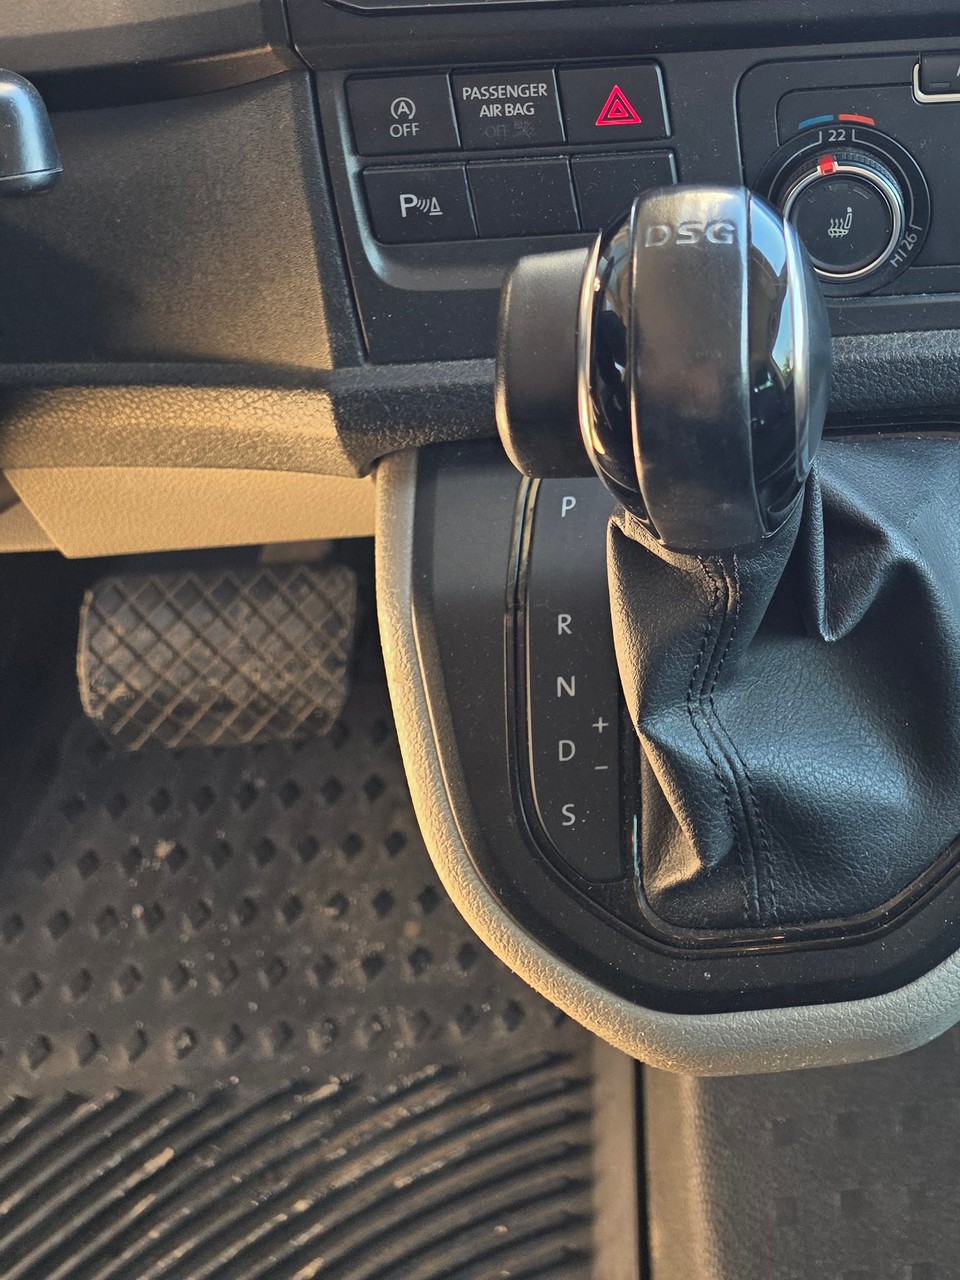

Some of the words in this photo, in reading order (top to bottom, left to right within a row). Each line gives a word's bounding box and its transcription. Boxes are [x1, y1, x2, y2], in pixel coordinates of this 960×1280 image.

[462, 83, 548, 101] PASSENGER
[479, 104, 502, 118] AIR
[504, 102, 535, 117] BAG
[389, 123, 420, 138] OFF
[828, 129, 846, 142] 22
[644, 222, 735, 248] DSG
[890, 248, 908, 268] HI
[902, 232, 918, 252] 26
[561, 496, 576, 518] P
[557, 613, 572, 635] R
[556, 676, 576, 698] N
[558, 740, 576, 762] D
[561, 803, 576, 827] S
